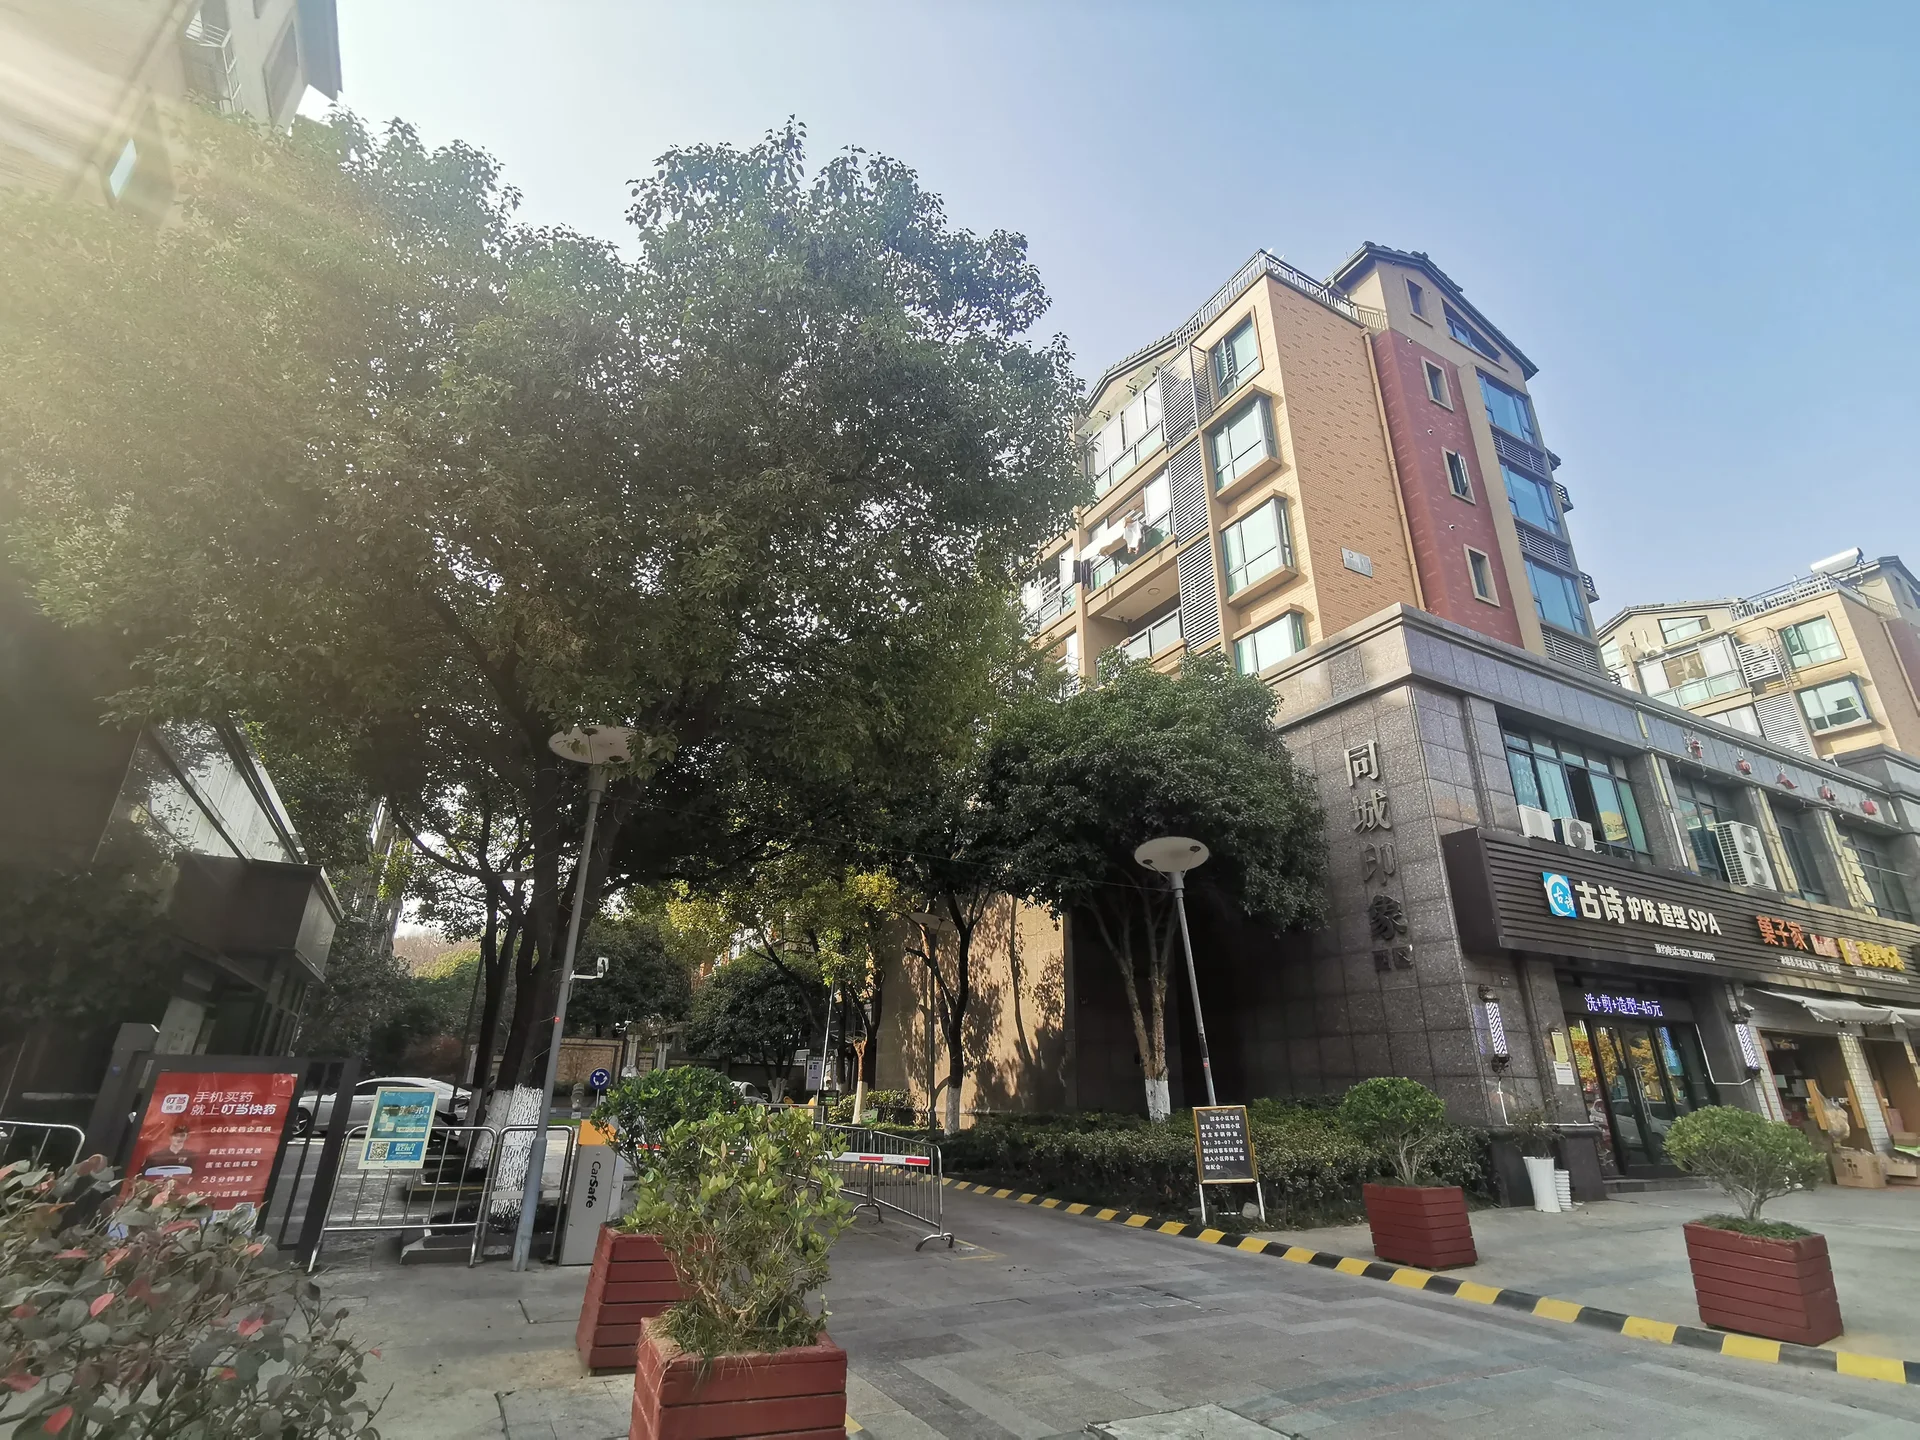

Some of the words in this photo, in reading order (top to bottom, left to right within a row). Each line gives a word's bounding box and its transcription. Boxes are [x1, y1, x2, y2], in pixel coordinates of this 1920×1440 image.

[1344, 739, 1408, 940] 同城印象
[1575, 881, 1625, 924] 古诗
[1626, 896, 1660, 925] 护肤
[1657, 902, 1690, 930] 造型
[1688, 908, 1722, 936] SPA
[193, 1091, 255, 1103] 手机买药
[585, 1161, 602, 1209] CarSafe
